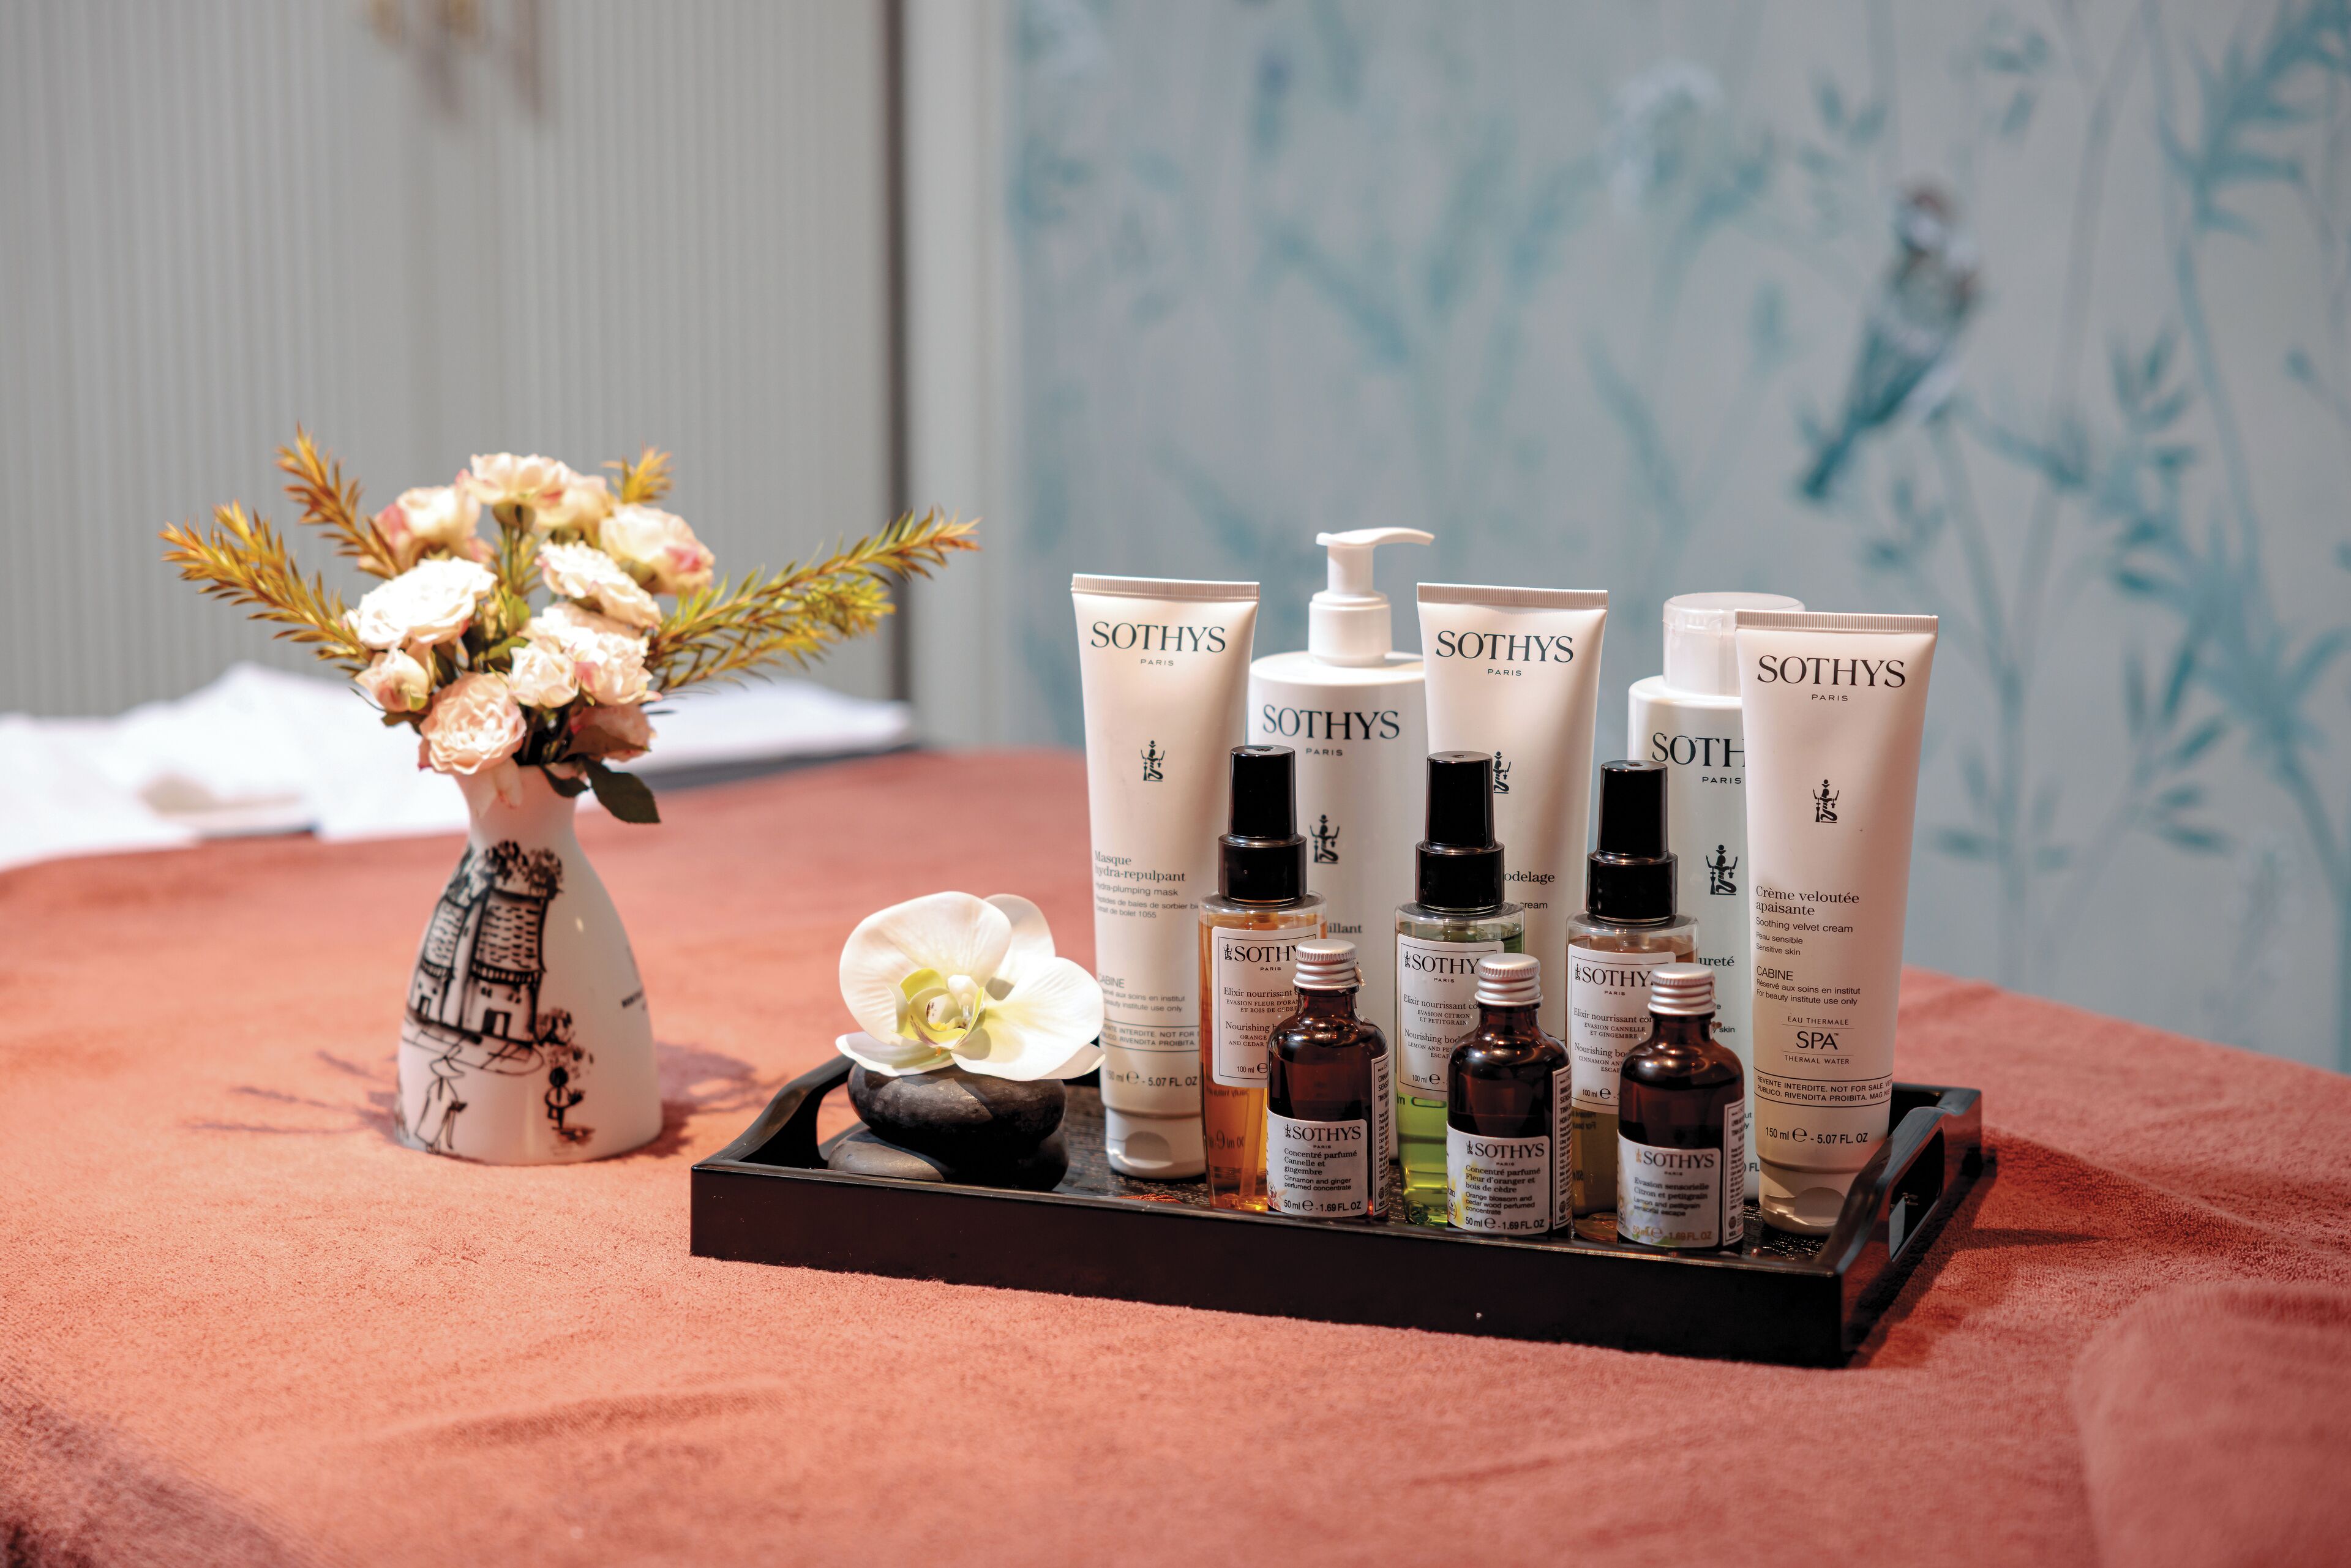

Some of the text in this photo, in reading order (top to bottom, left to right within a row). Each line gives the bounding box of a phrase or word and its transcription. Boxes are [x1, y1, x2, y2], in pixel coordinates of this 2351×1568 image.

[1090, 621, 1226, 653] SOTHYS
[1436, 630, 1573, 662] SOTHYS
[1757, 655, 1906, 688] SOTHYS
[1263, 704, 1400, 740] SOTHYS
[1652, 732, 1745, 767] SOTH
[1095, 850, 1131, 866] Masque
[1504, 871, 1554, 885] odelage
[1756, 885, 1859, 904] Crème veloutée
[1756, 901, 1815, 915] apaisante
[1327, 923, 1362, 933] illant
[1756, 917, 1790, 931] Soothing
[1793, 923, 1820, 931] velvet
[1756, 931, 1803, 944] Peau sensible
[1234, 945, 1297, 962] SOTH
[1756, 943, 1782, 954] Sensitive
[1412, 954, 1480, 974] SOTHY
[1699, 956, 1734, 966] ureté
[1583, 967, 1653, 987] SOTHY
[1757, 966, 1794, 981] CABINE
[1757, 978, 1779, 989] Réservé
[1224, 987, 1244, 996] Elixir
[1247, 989, 1292, 997] nourrissant
[1766, 991, 1788, 1002] beauty
[1790, 995, 1821, 1004] institute
[1122, 1002, 1148, 1010] institute
[1403, 994, 1420, 1005] Elixir
[1422, 1000, 1466, 1010] nourrissant
[1573, 1007, 1589, 1019] Elixir
[1225, 1021, 1270, 1033] Nourishing
[1119, 1037, 1156, 1046] RIVENDITA
[1404, 1029, 1442, 1045] Nourishing
[1575, 1042, 1613, 1059] Nourishing
[1579, 1056, 1609, 1065] CINNAMON
[1785, 1055, 1820, 1063] THERMAL
[1148, 1077, 1198, 1086] 5.07 FL. OZ
[1757, 1076, 1782, 1087] REVENTE
[1784, 1082, 1828, 1092] INTERDITE.
[1757, 1085, 1782, 1097] PUBLICO.
[1785, 1092, 1826, 1101] RIVENDITA
[1292, 1126, 1361, 1141] SOTHYS
[1766, 1127, 1868, 1144] 150 ml 5.07 FL. OZ
[1284, 1148, 1357, 1160] Concentré parfumé
[1475, 1143, 1544, 1158] SOTHYS
[1284, 1157, 1315, 1167] Cannelle
[1643, 1151, 1714, 1168] SOTHYS
[1284, 1165, 1322, 1175] gingembre
[1466, 1165, 1540, 1177] Concentré parfumé
[1284, 1174, 1313, 1184] Cinnamon
[1466, 1174, 1485, 1182] Fleur
[1634, 1177, 1663, 1188] Evasion
[1634, 1187, 1655, 1197] Citron
[1284, 1199, 1291, 1209] 50
[1292, 1201, 1300, 1210] ml
[1338, 1202, 1349, 1211] FL.
[1351, 1201, 1362, 1210] OZ
[1634, 1196, 1652, 1205] Lemon
[1466, 1206, 1501, 1215] concentrate
[1700, 1231, 1712, 1240] OZ
